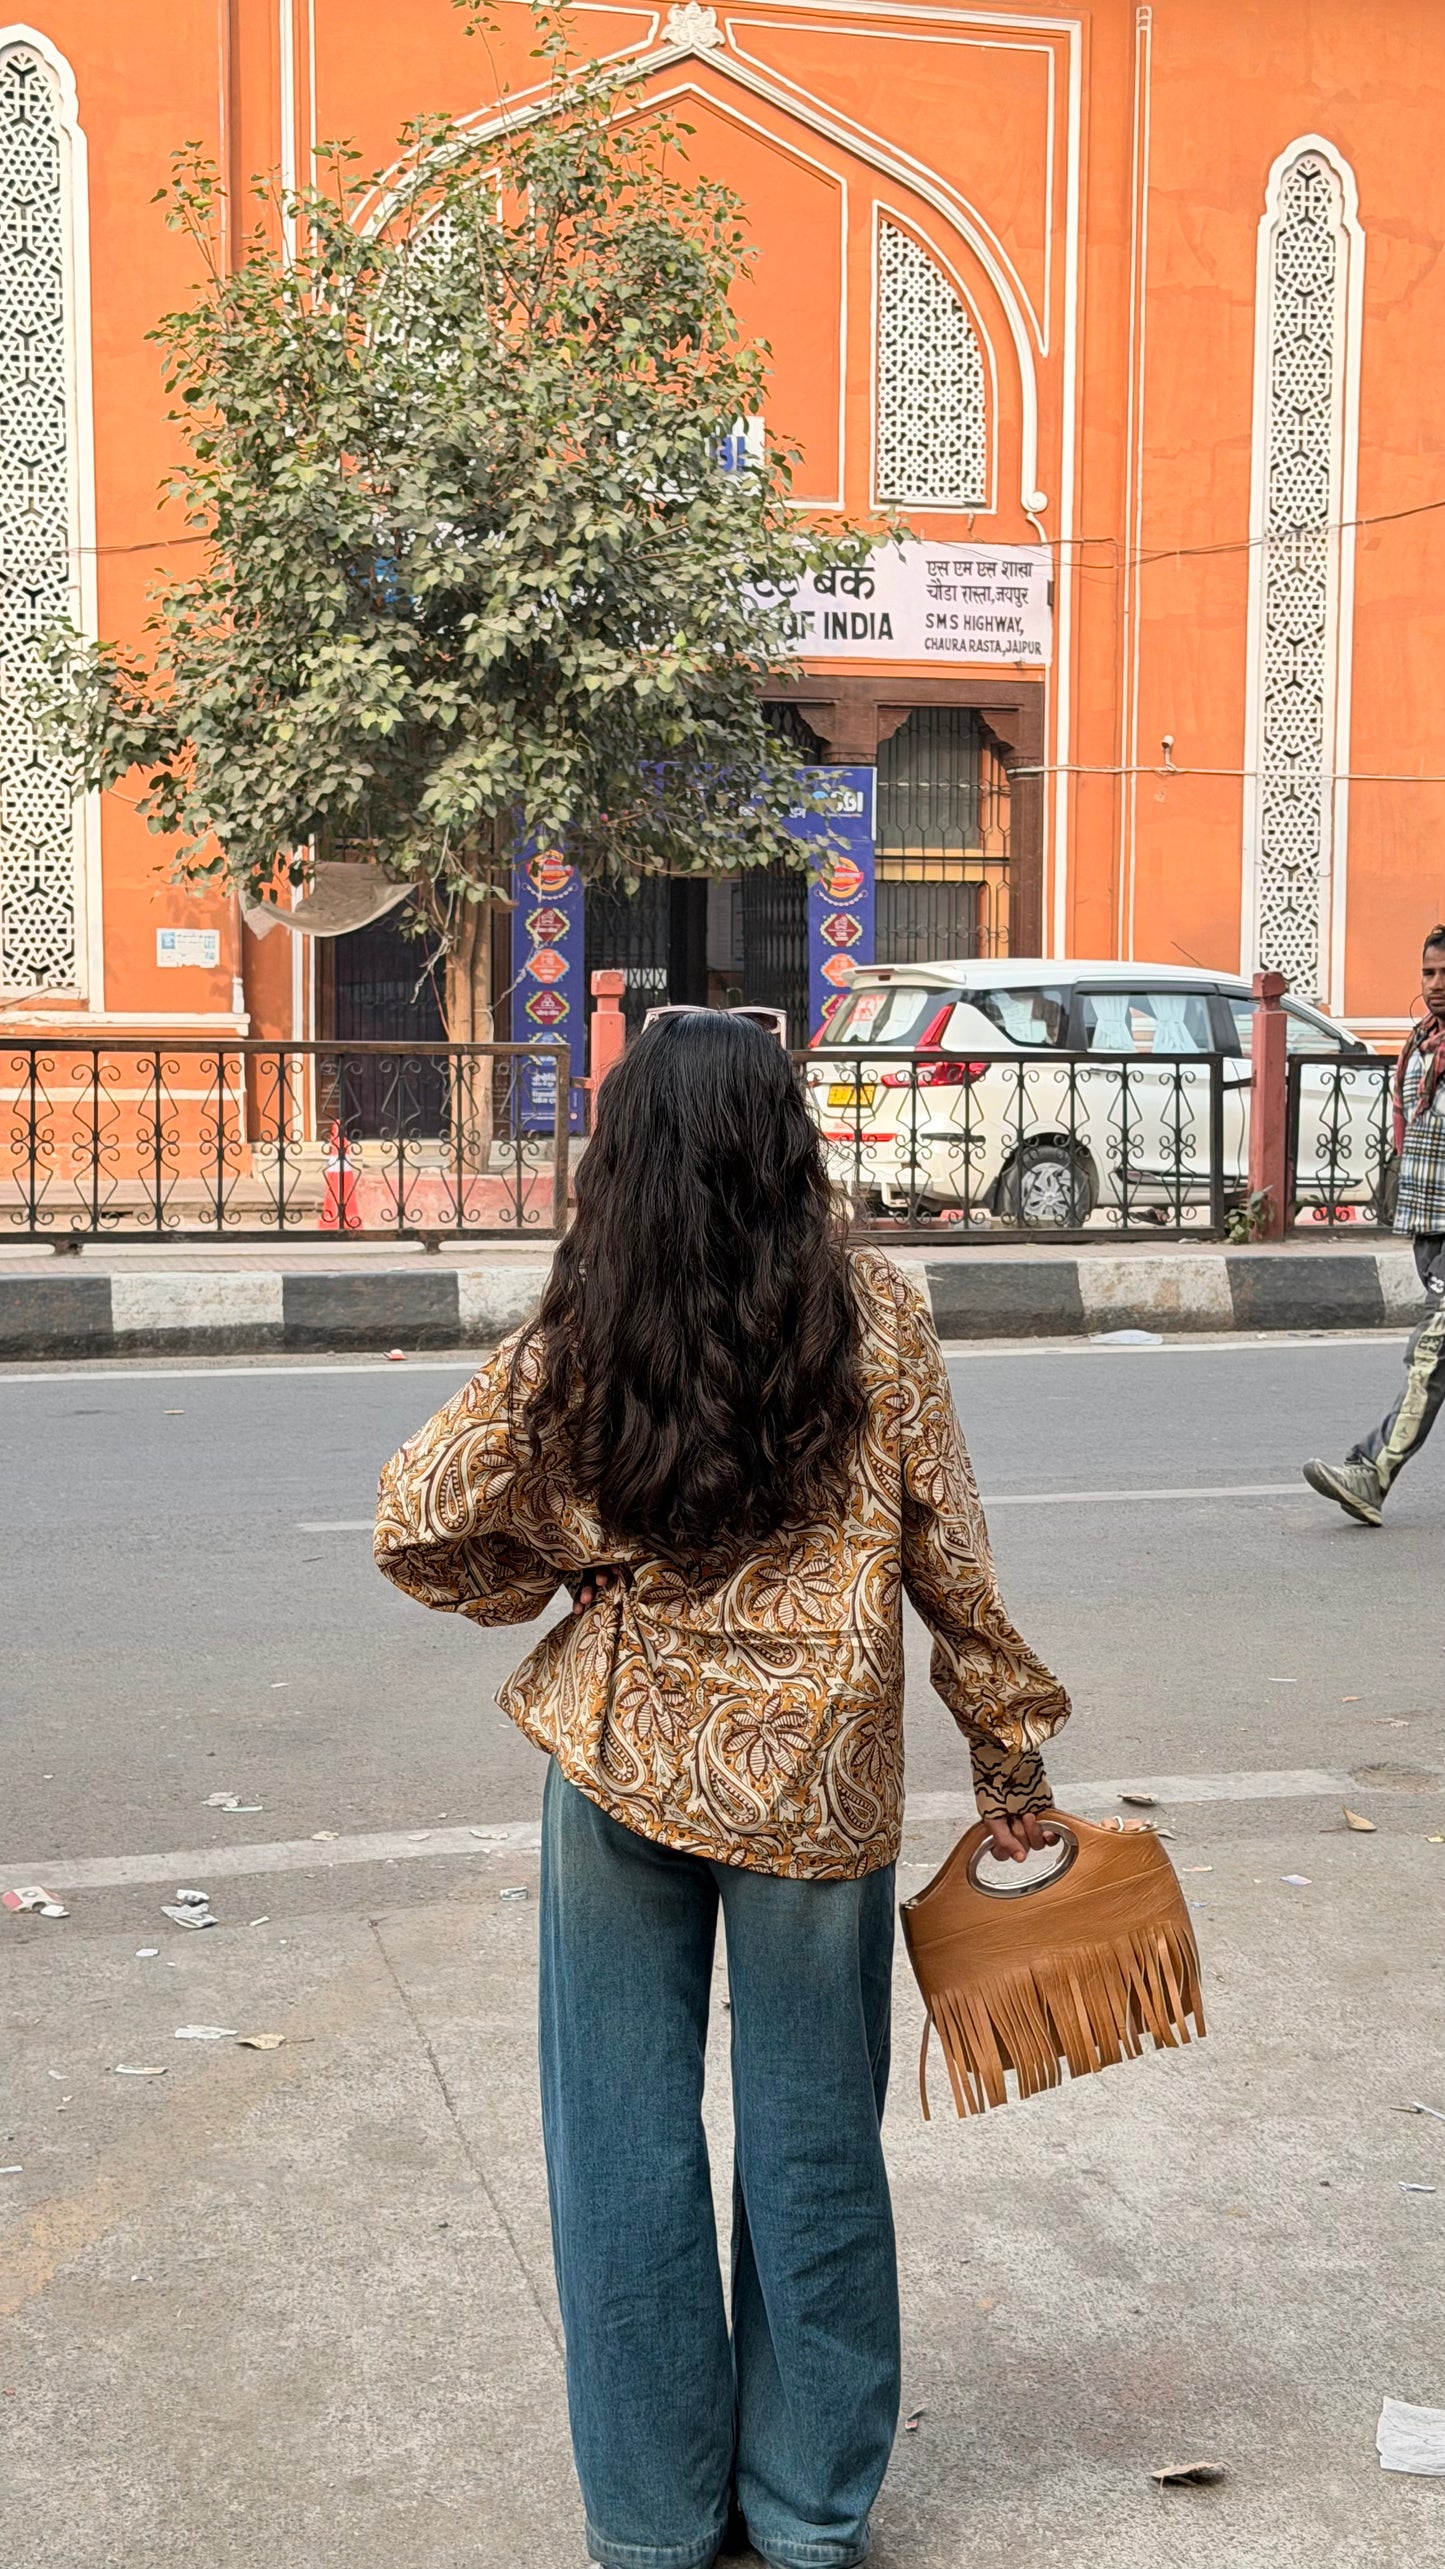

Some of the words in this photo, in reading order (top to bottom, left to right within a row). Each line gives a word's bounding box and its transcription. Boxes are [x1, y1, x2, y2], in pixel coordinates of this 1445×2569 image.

[925, 560, 950, 577] एस
[953, 561, 973, 576] एम
[975, 562, 998, 578] एस
[1001, 561, 1034, 579] शाखा
[824, 611, 894, 640] INDIA
[963, 614, 1024, 636] HIGHWAY,
[924, 637, 967, 652] CHAURA
